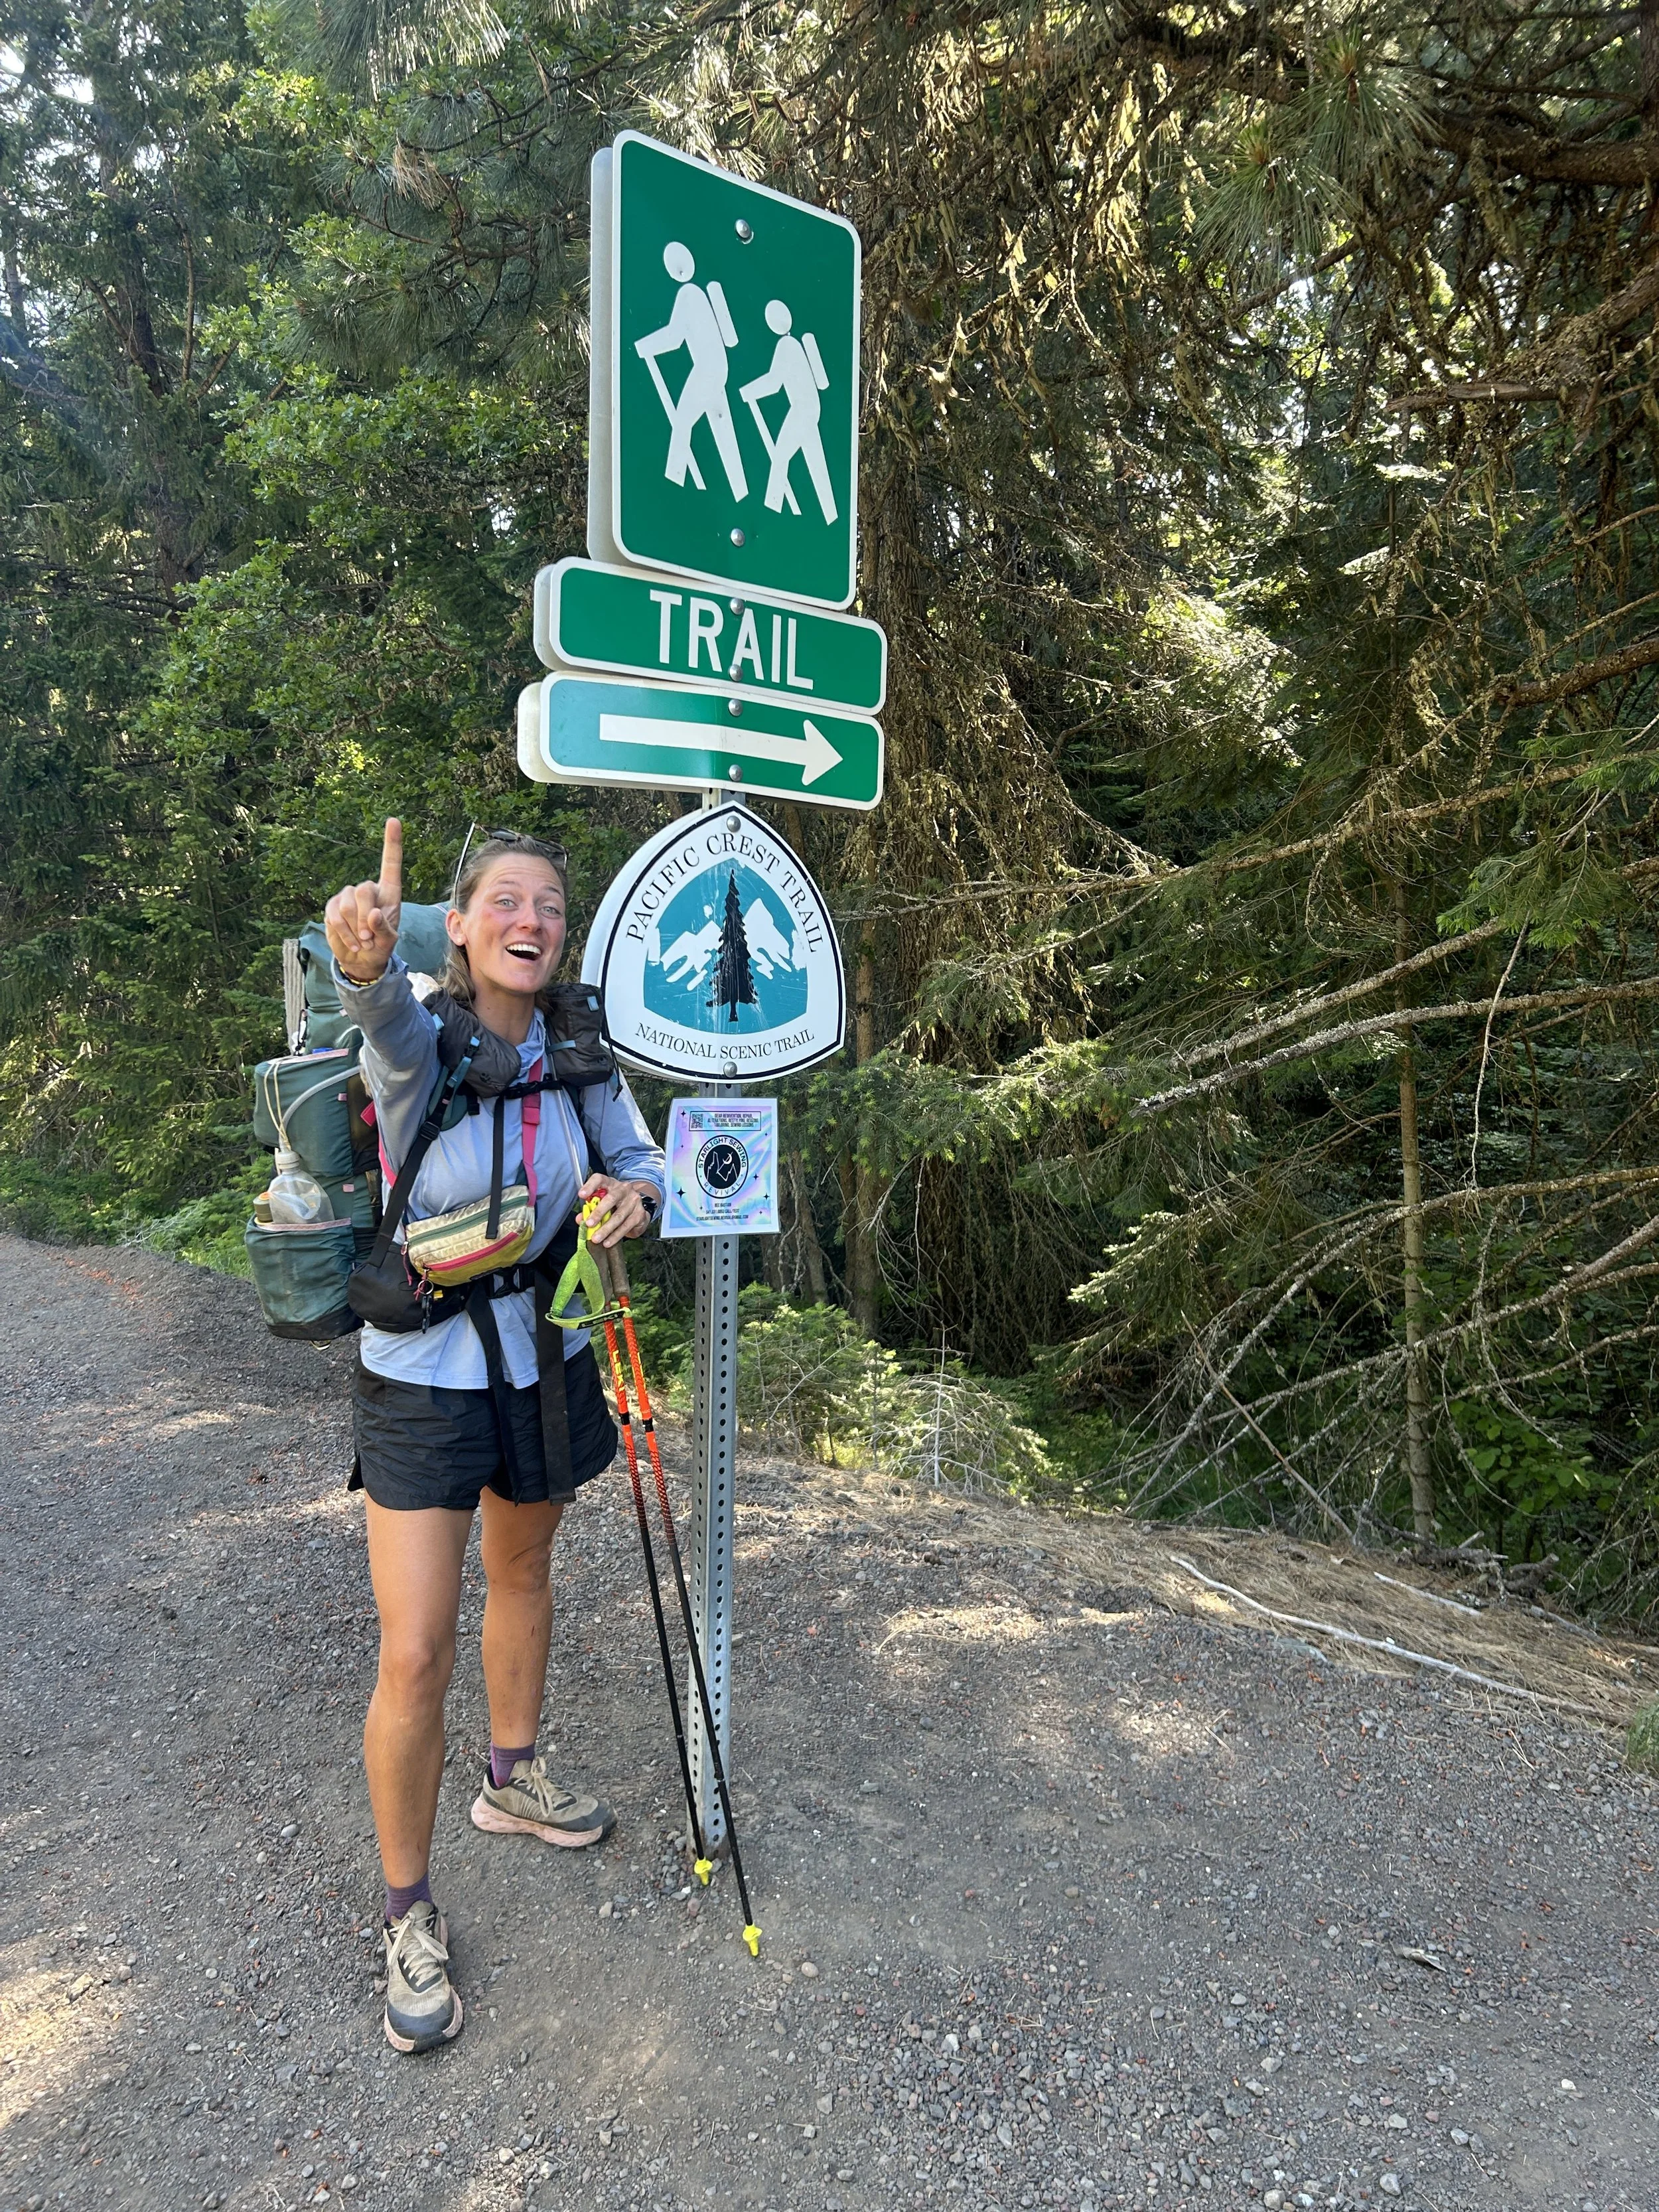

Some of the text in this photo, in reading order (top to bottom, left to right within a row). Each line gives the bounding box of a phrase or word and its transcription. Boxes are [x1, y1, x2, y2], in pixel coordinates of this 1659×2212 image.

[650, 589, 814, 690] TRAIL
[626, 833, 824, 953] PACIFIC CREST TRAIL
[634, 1023, 815, 1059] NATIONAL SCENIC TRAIL
[698, 1137, 747, 1169] STARLIGHT SEWING
[703, 1181, 741, 1195] REVIVAL
[612, 1349, 626, 1392] LEKI
